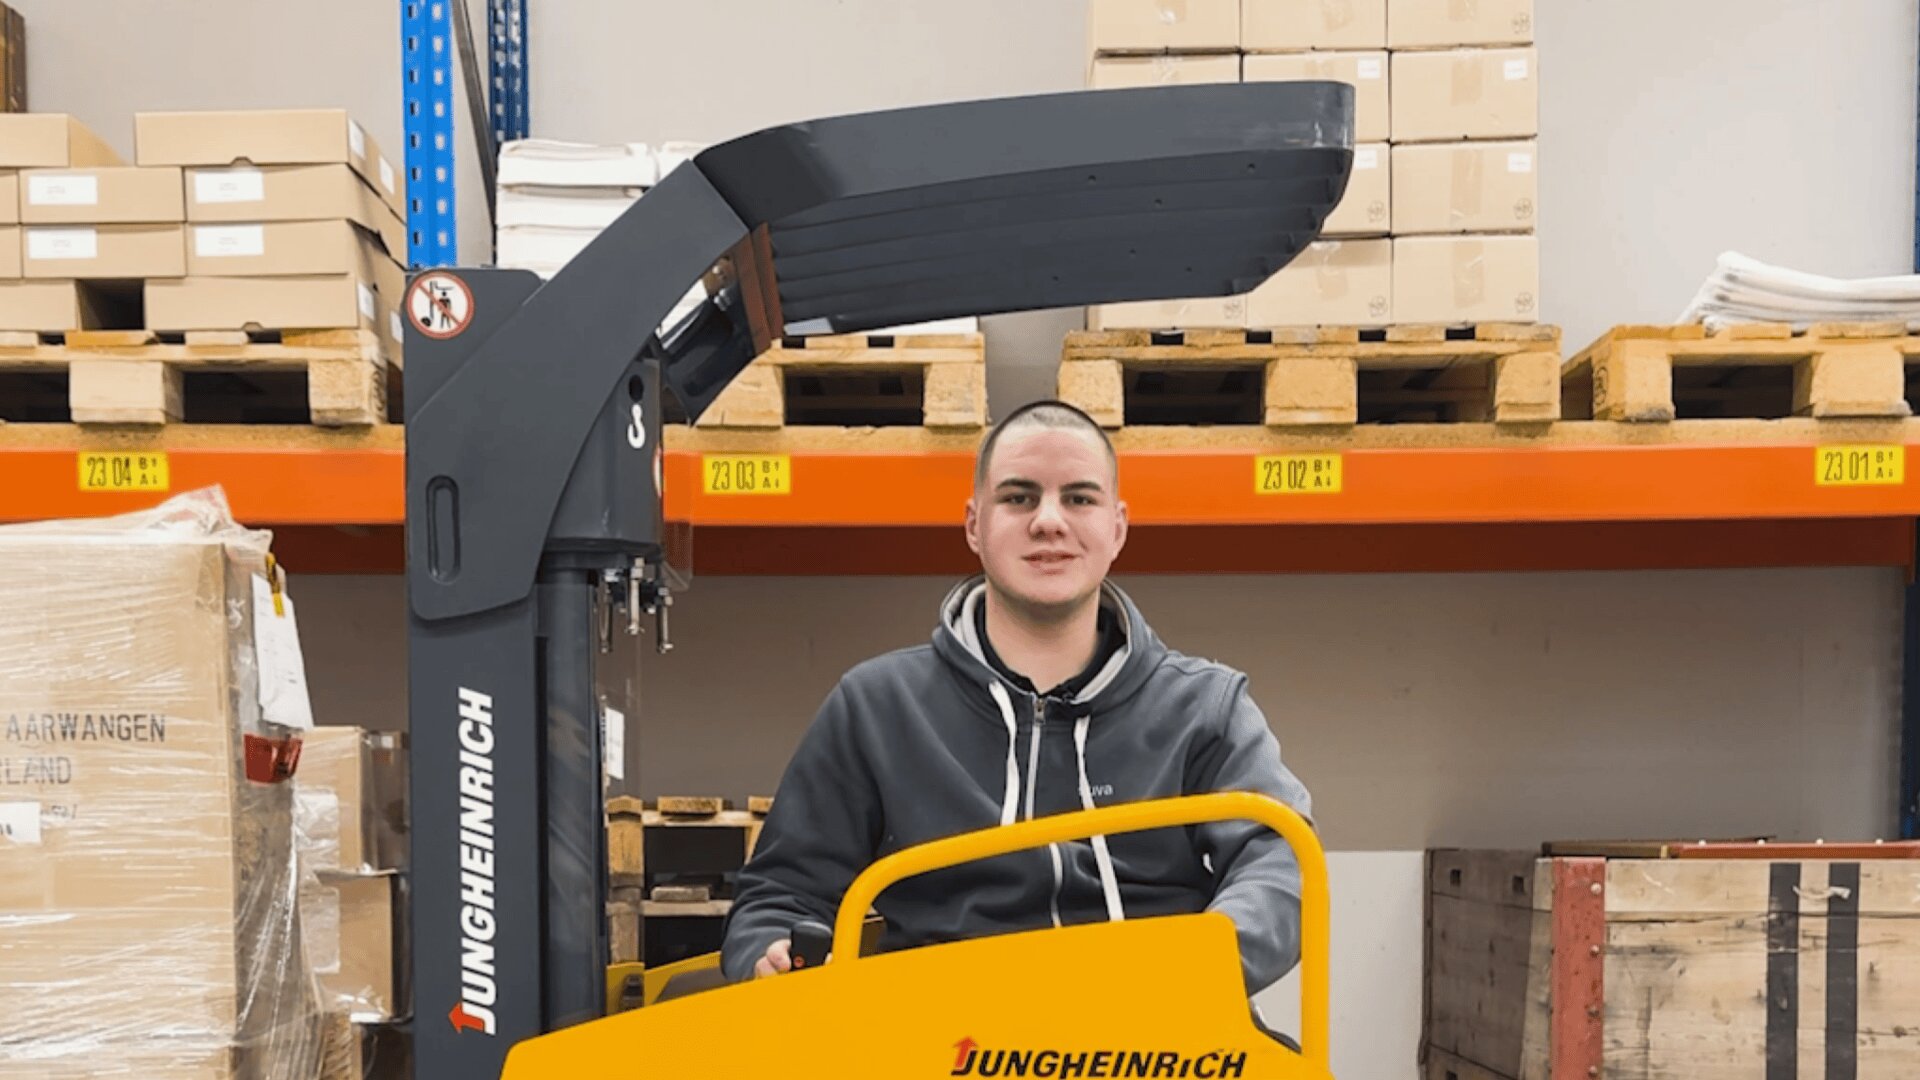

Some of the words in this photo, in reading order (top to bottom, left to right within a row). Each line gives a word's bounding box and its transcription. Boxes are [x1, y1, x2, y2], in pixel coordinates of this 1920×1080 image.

[87, 457, 106, 487] 23
[112, 457, 132, 487] 04
[712, 460, 730, 490] 23
[736, 460, 755, 490] 03
[1263, 460, 1282, 490] 23
[1288, 460, 1307, 489] 02
[1824, 451, 1843, 481] 23
[1849, 451, 1869, 481] 01
[6, 713, 166, 742] AARWANGEN
[0, 756, 71, 785] LAND
[458, 686, 496, 1035] JUNGHEINRICH
[951, 1049, 1248, 1080] JUNGHEINRICH
